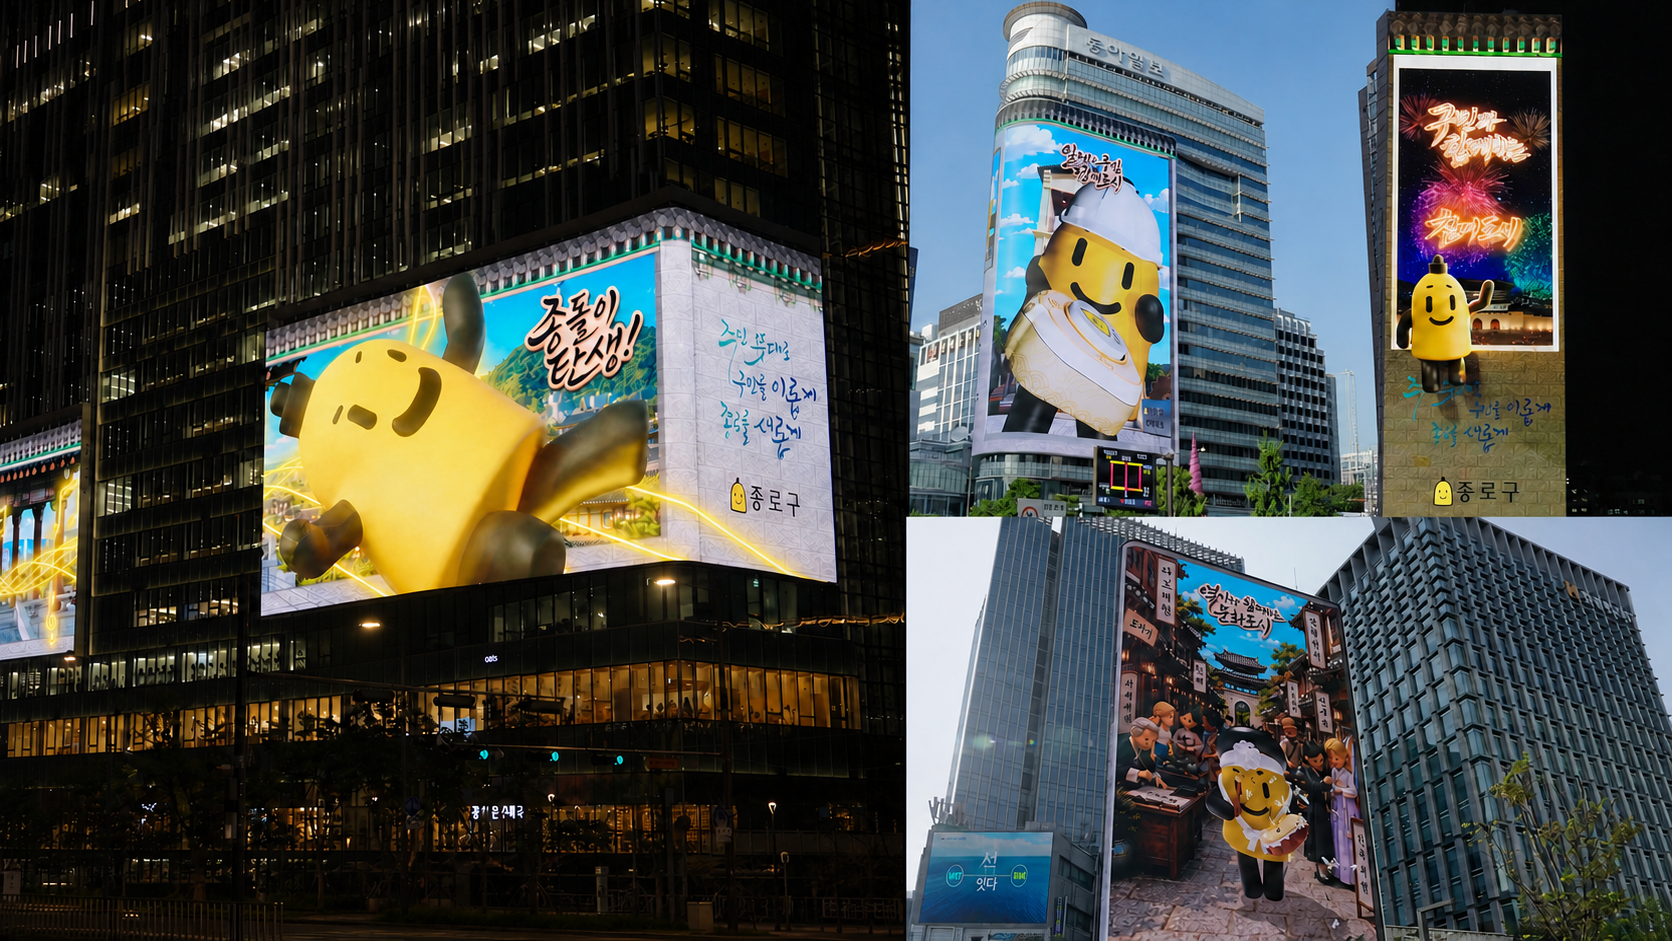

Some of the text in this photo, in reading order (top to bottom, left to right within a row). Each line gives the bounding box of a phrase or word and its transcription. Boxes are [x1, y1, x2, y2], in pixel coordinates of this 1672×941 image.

[1087, 37, 1164, 78] 동아일보
[528, 289, 617, 355] 종돌이
[547, 313, 641, 387] 탄생!
[749, 485, 801, 517] 종로구
[1456, 481, 1520, 503] 종로구
[1213, 604, 1271, 637] 문화도시
[976, 876, 998, 892] 잇다
